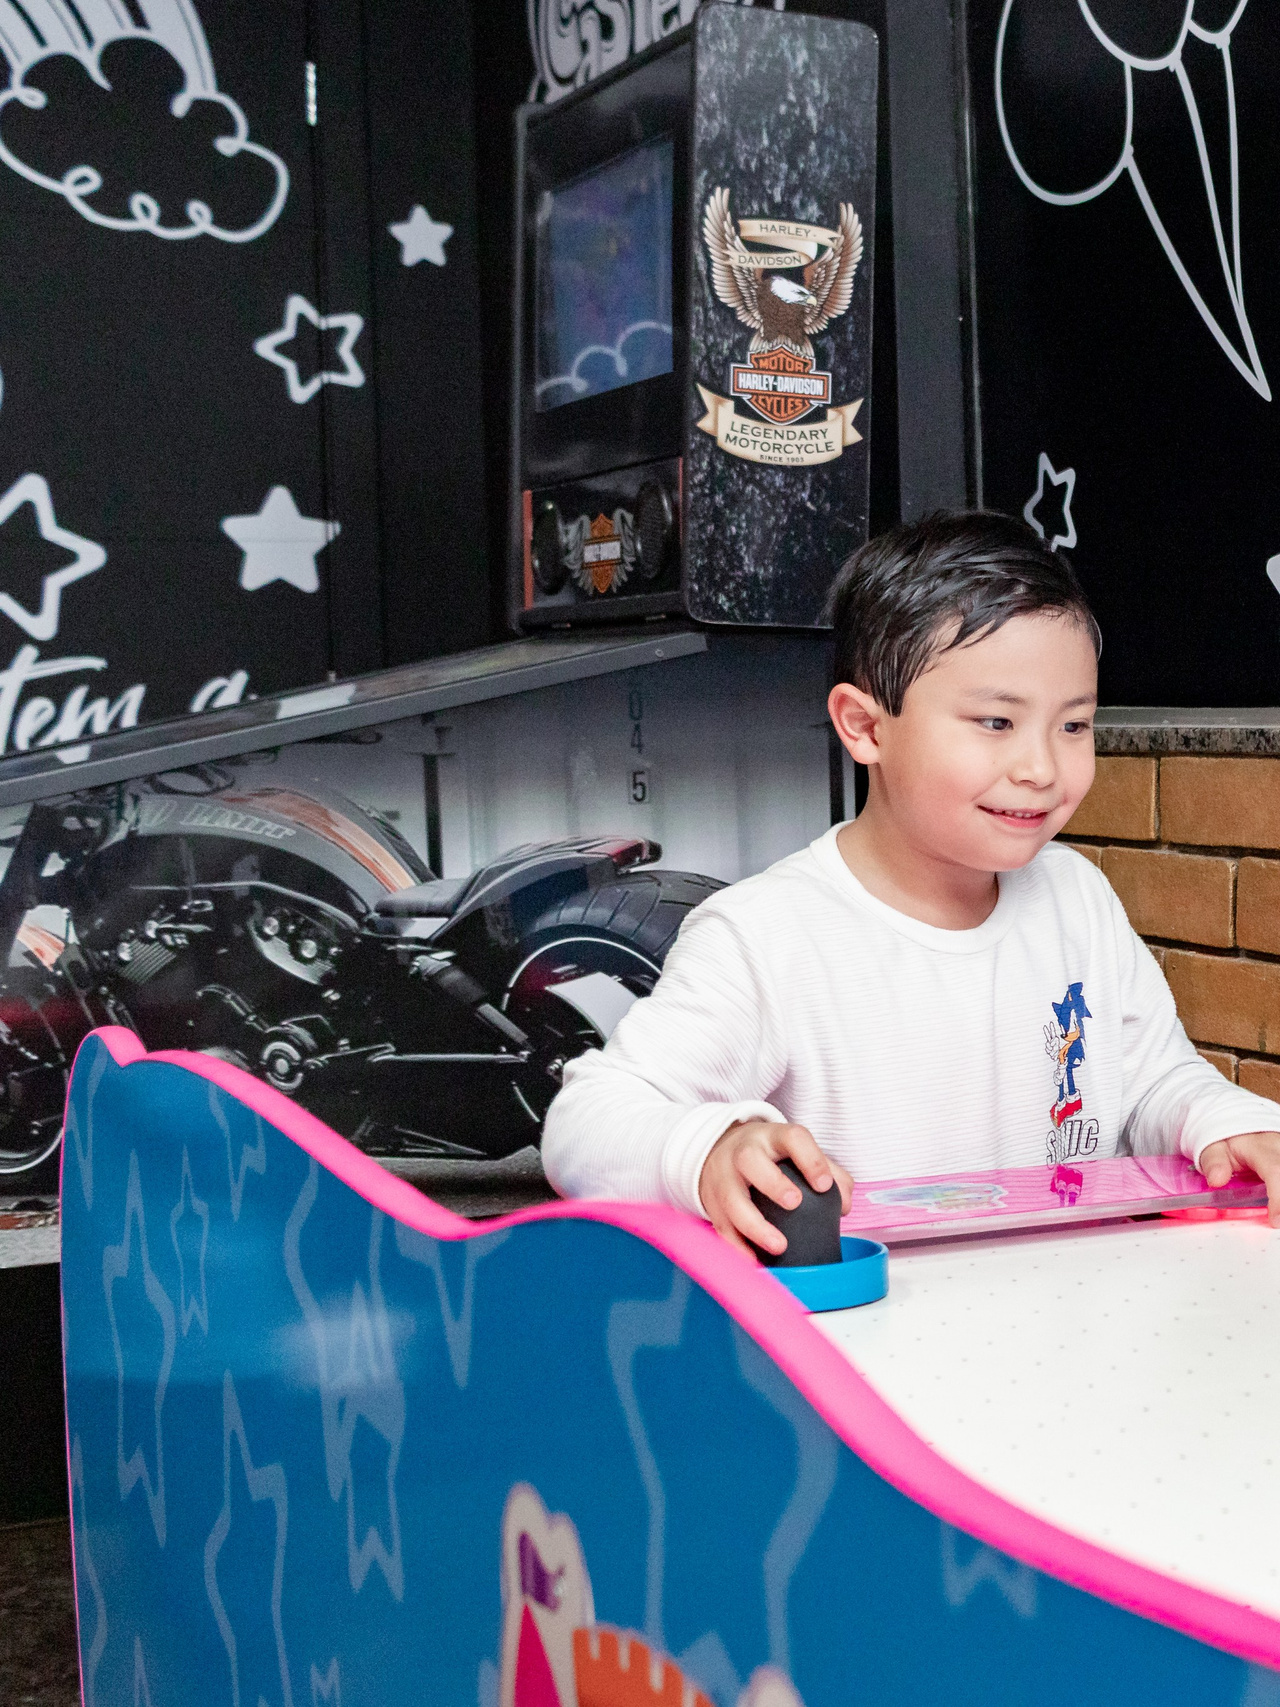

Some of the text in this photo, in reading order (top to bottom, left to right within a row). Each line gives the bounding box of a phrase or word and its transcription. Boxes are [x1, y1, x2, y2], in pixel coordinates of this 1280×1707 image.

[738, 254, 802, 266] DAVIDSON
[759, 354, 806, 373] MOTOR
[737, 372, 824, 396] HARLEY-DAVIDSON
[757, 396, 803, 418] CYCLES
[730, 421, 829, 441] LEGENDARY
[724, 433, 835, 455] MOTORCYCLE
[759, 454, 784, 463] SINCE
